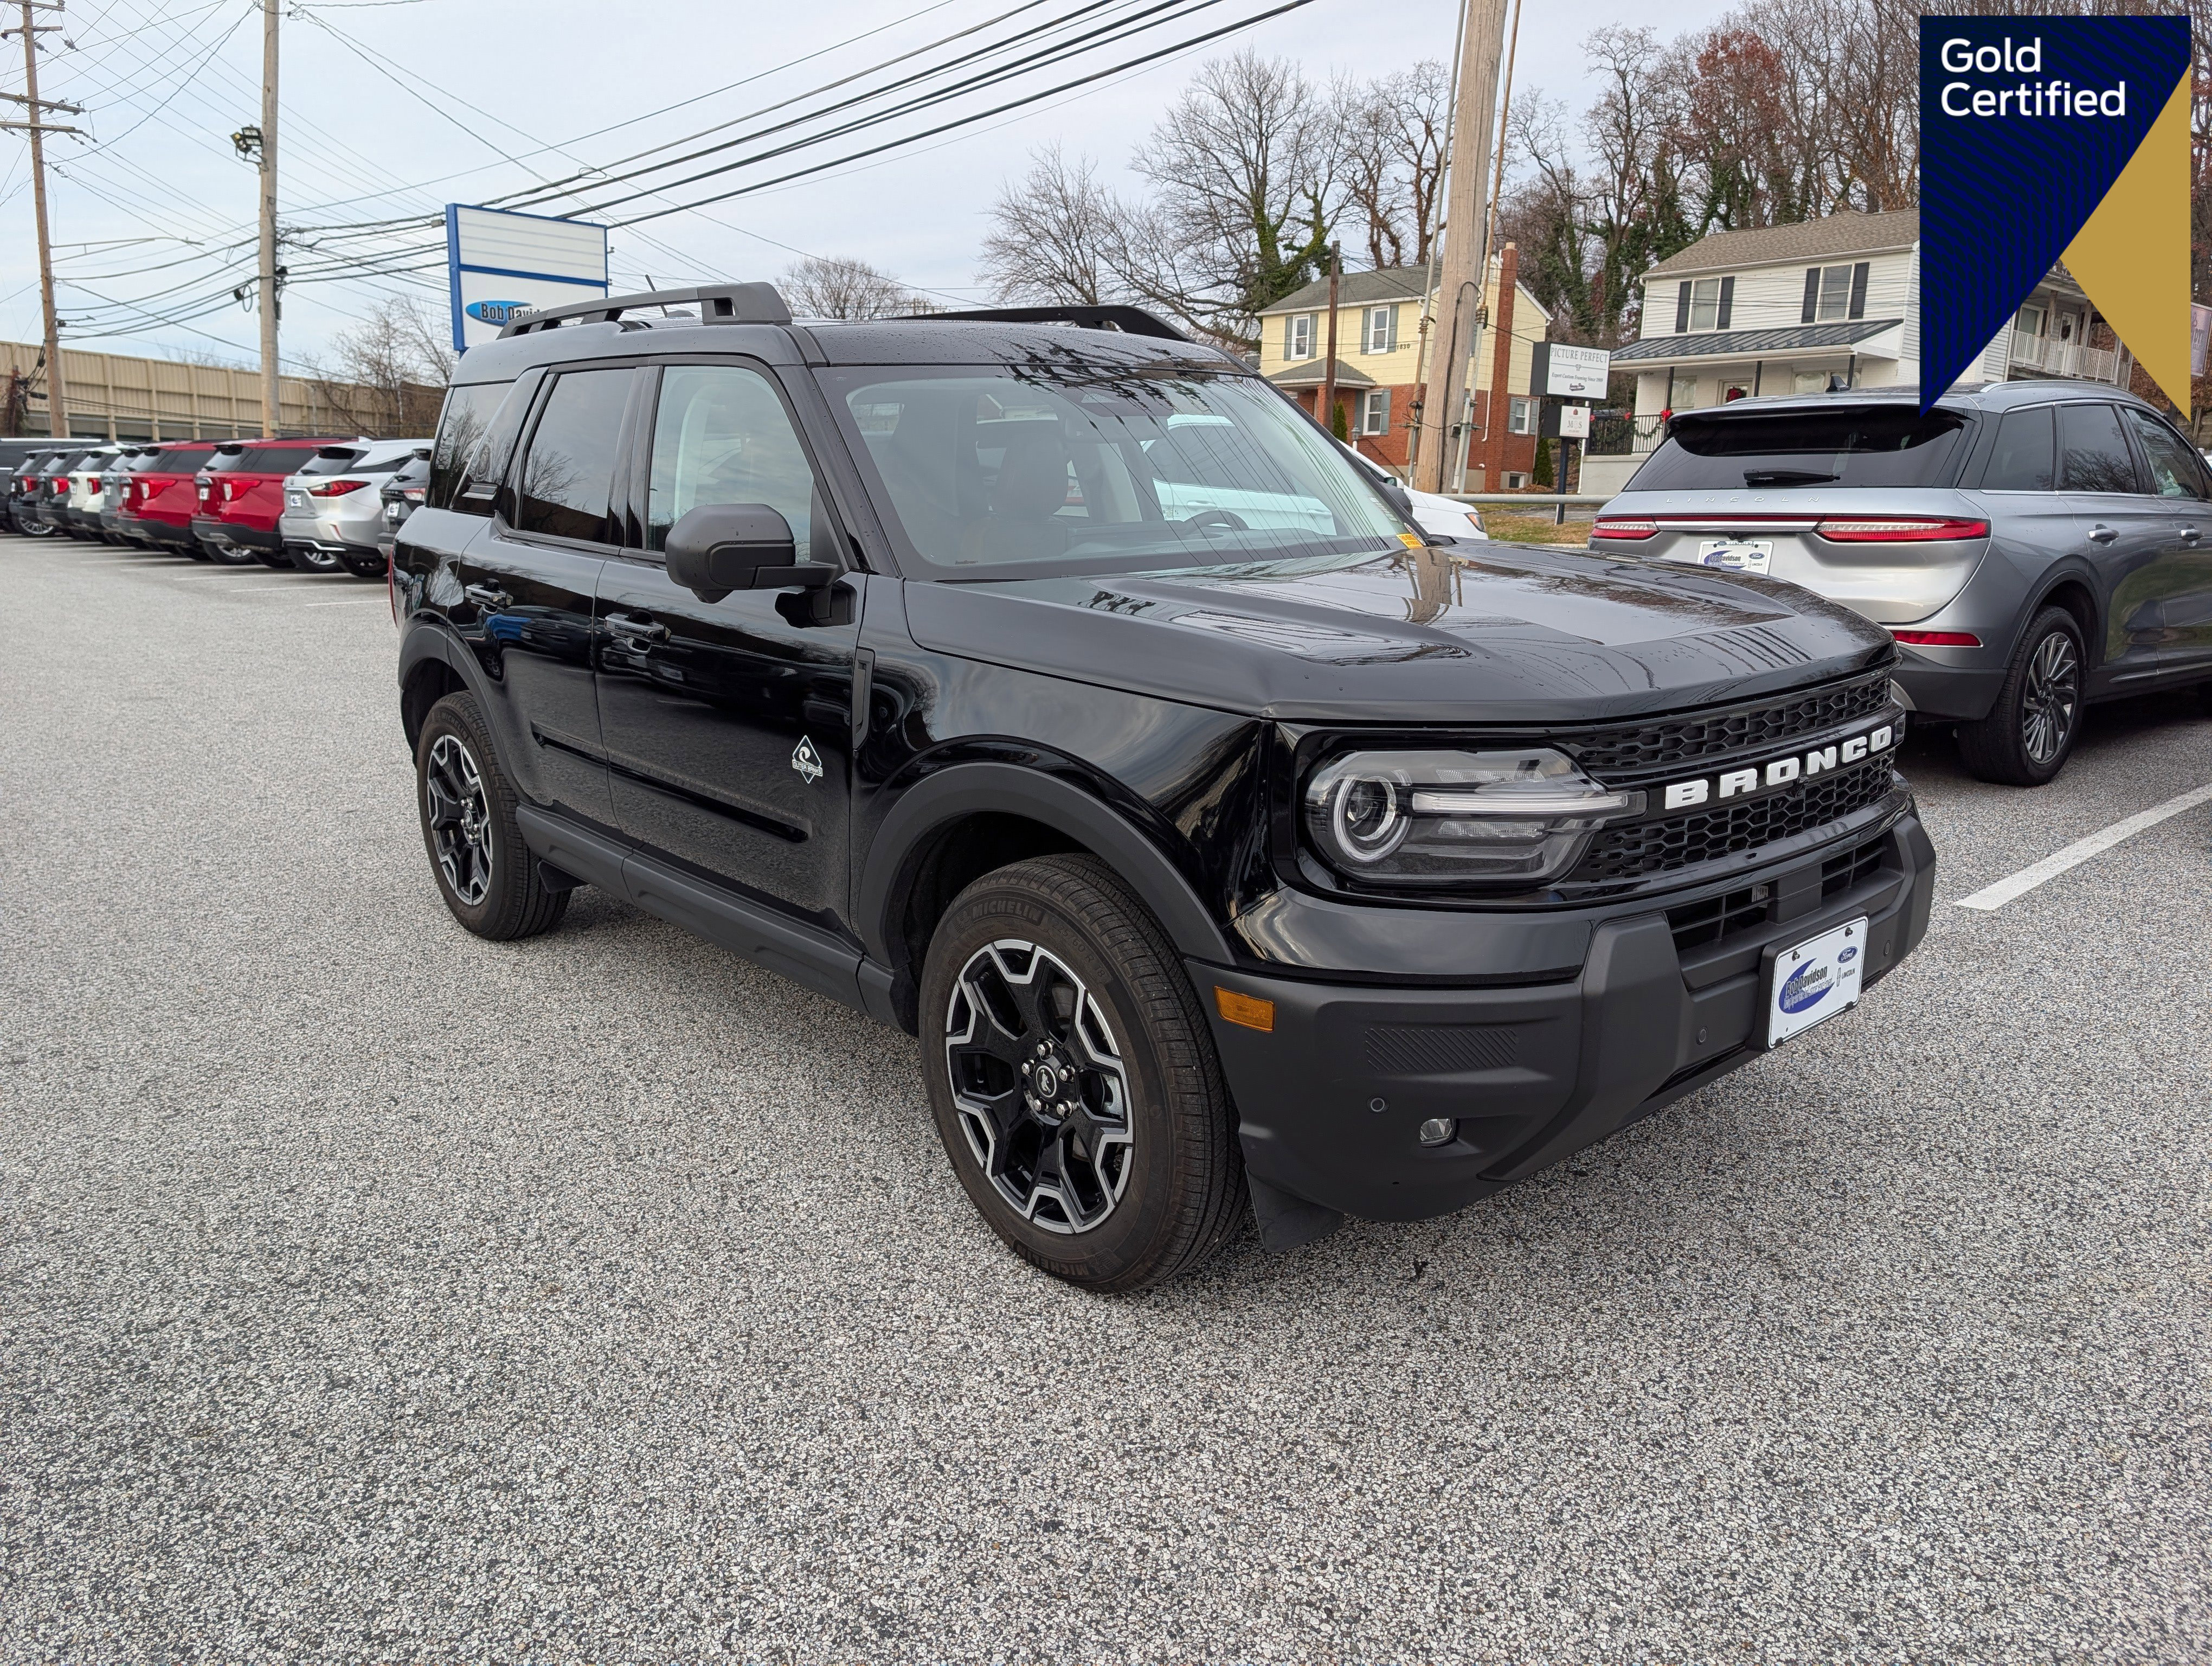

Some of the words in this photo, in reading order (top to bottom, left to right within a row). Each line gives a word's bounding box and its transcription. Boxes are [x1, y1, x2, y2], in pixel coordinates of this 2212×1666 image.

[481, 303, 503, 320] Bob
[1551, 348, 1579, 360] PICTURE
[1580, 351, 1608, 363] PERFECT
[793, 761, 807, 770] OUTER
[807, 765, 821, 774] BANKS
[1664, 726, 1892, 810] BRONCO
[972, 900, 1042, 921] MICHELIN
[1052, 923, 1086, 952] 225/60
[1786, 977, 1799, 997] Bob
[1799, 965, 1828, 990] Davidson
[1842, 967, 1855, 979] LINCOLN
[1016, 1243, 1090, 1276] MICHELIN
